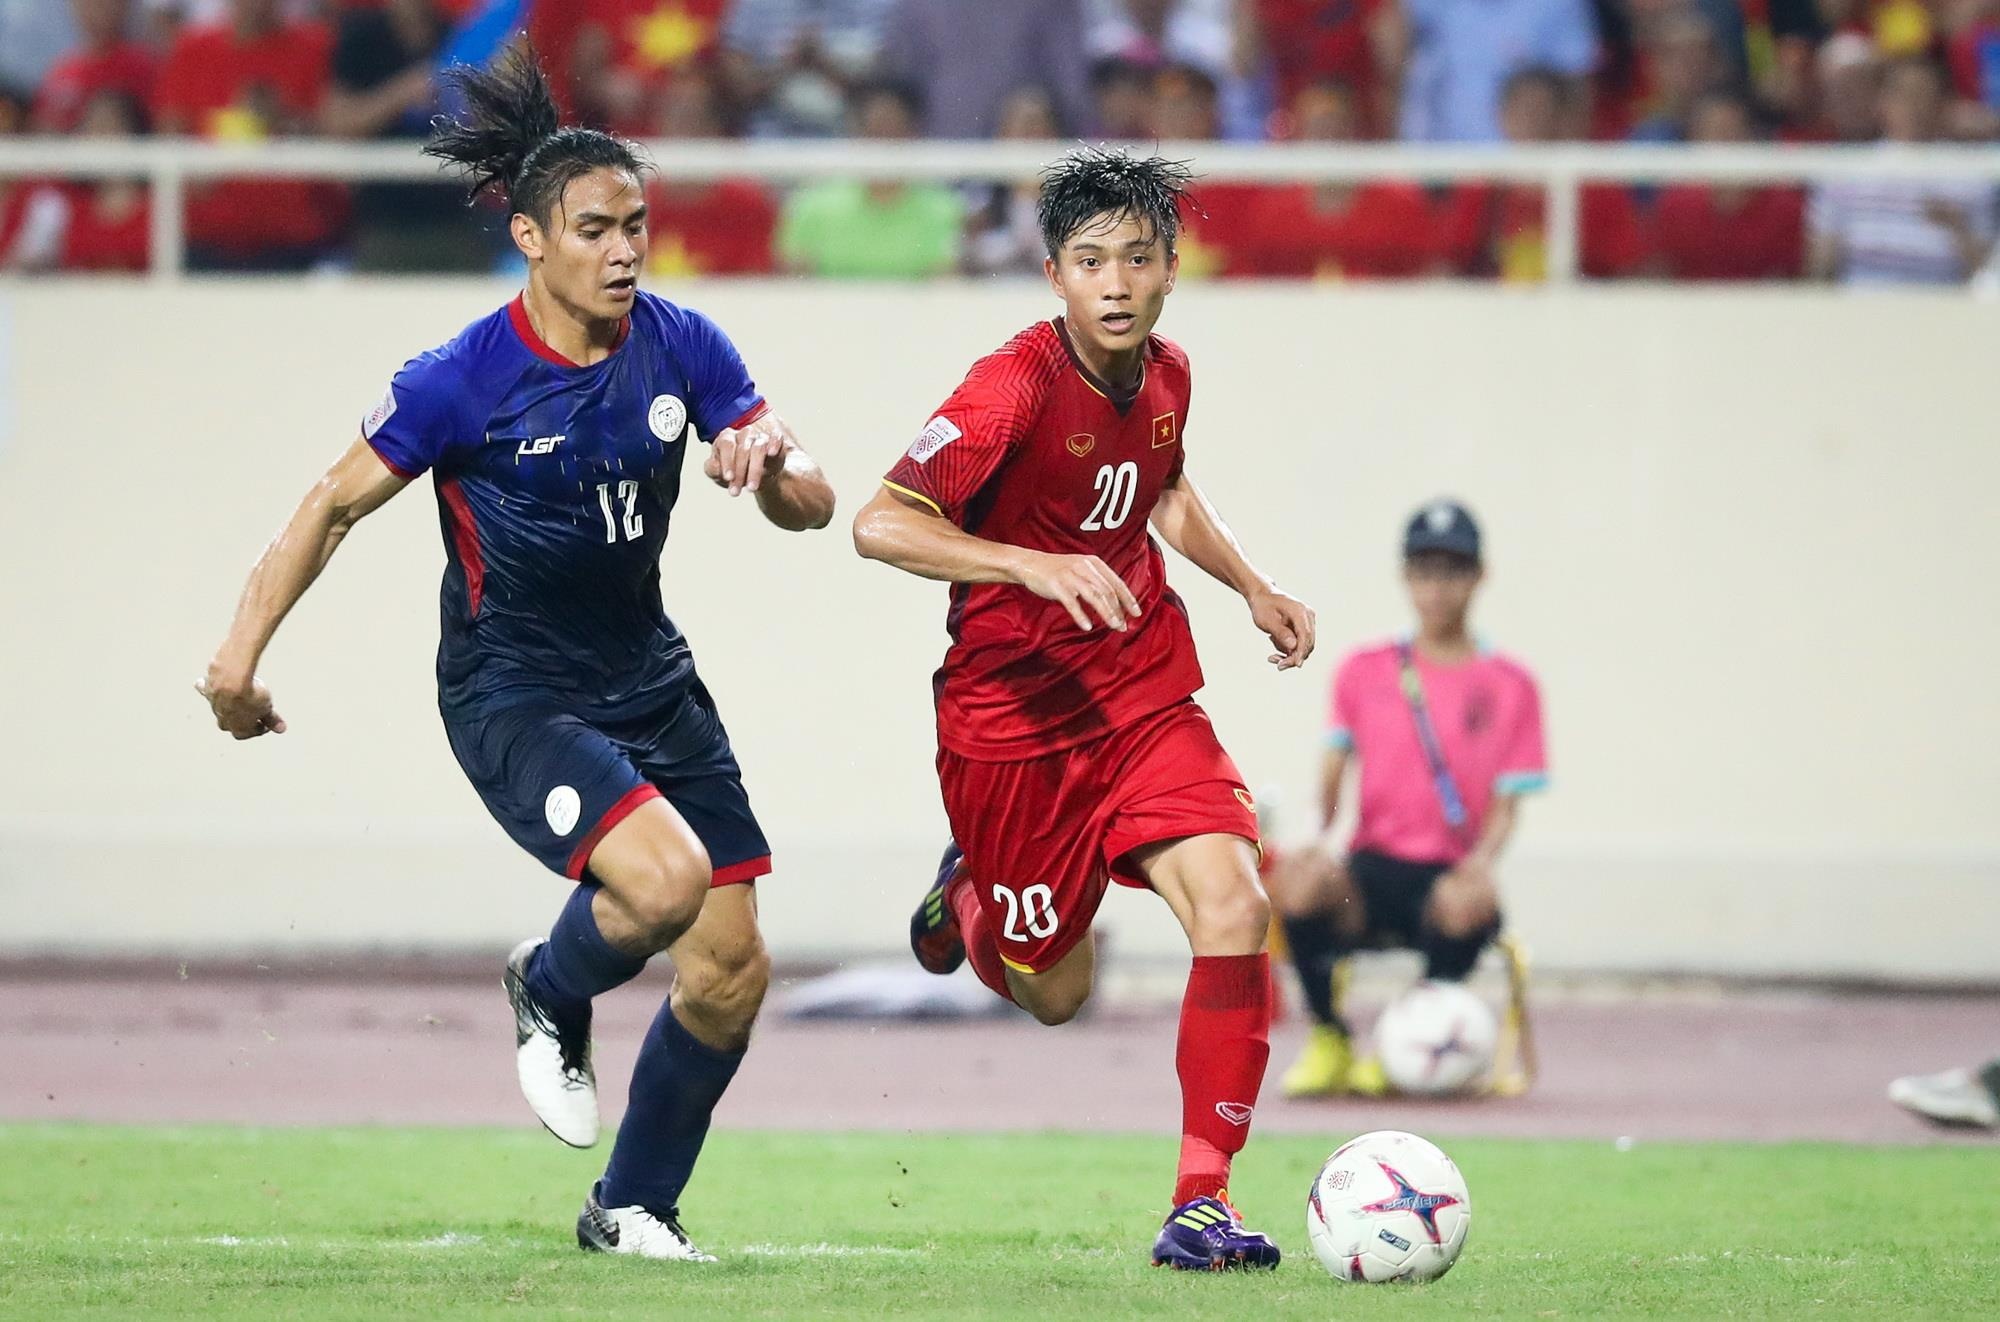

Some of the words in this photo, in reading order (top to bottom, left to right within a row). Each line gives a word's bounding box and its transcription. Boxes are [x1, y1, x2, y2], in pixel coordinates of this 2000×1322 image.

[596, 480, 643, 543] 12
[1080, 461, 1138, 531] 20
[993, 883, 1059, 942] 20
